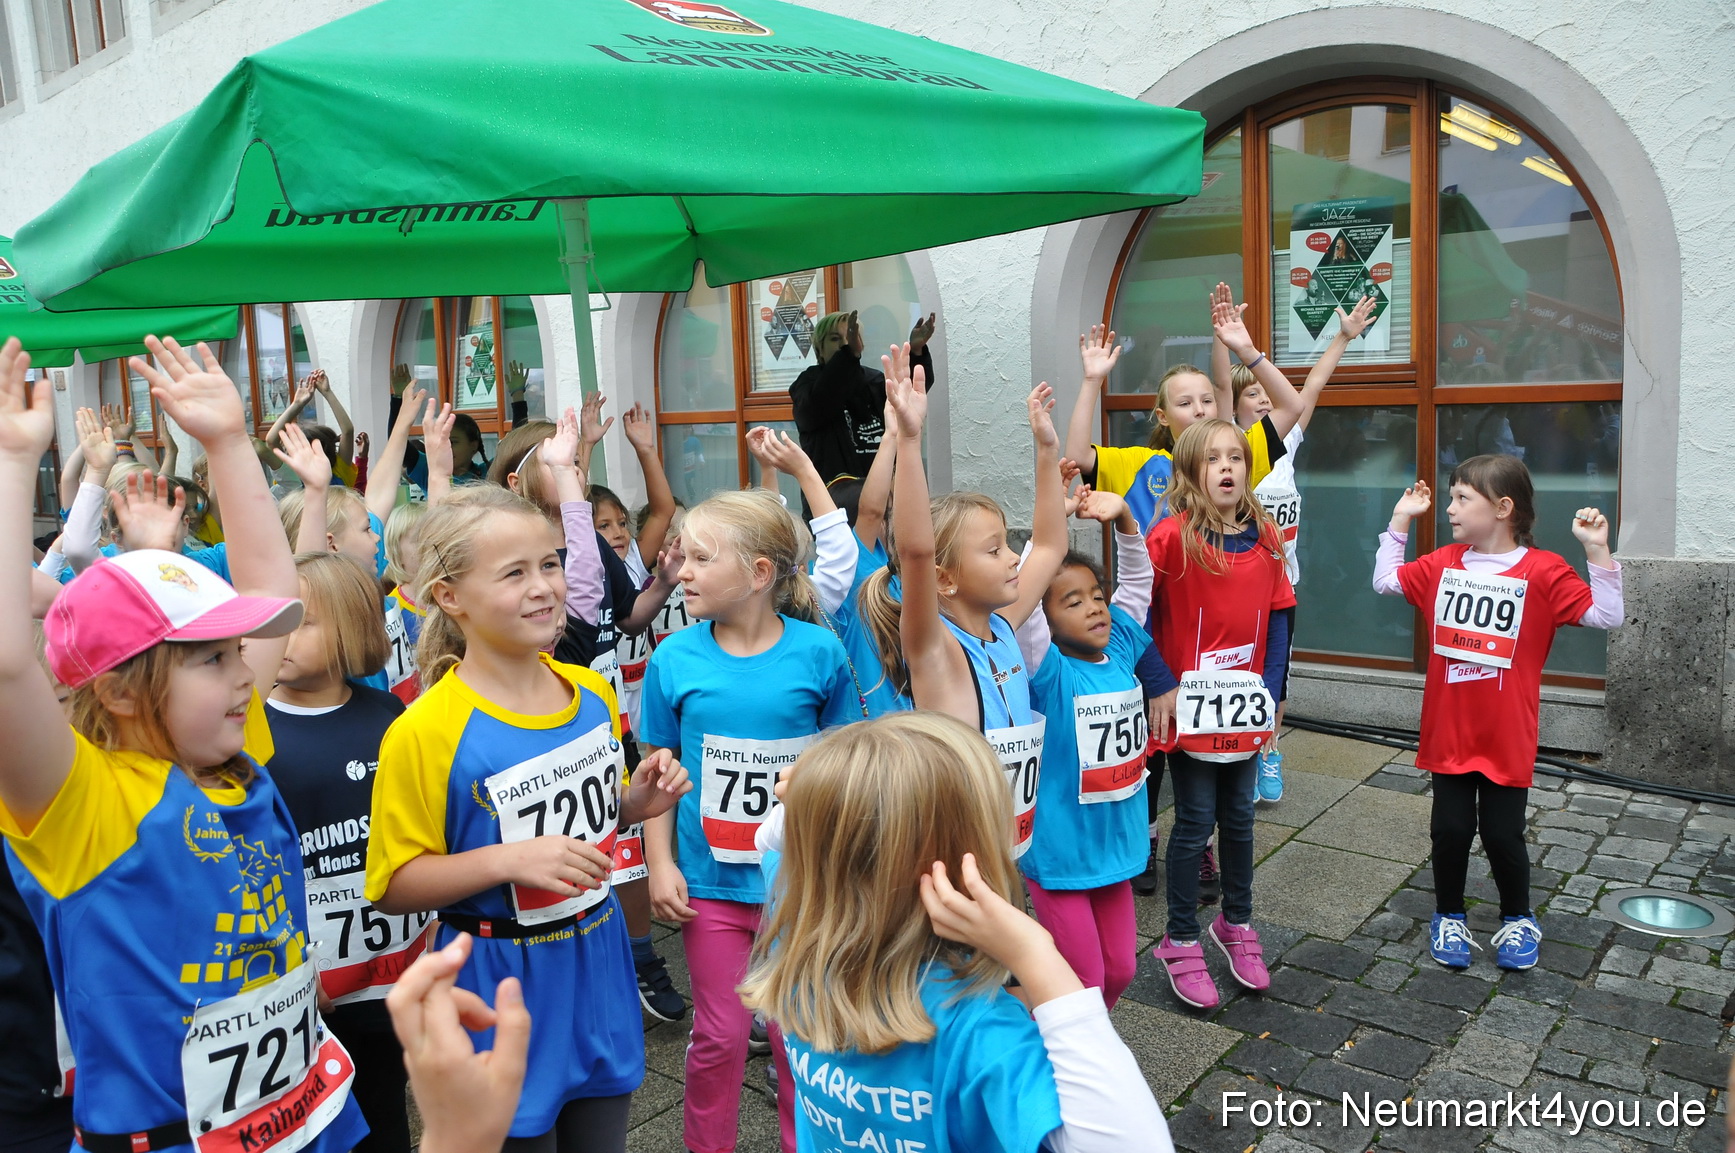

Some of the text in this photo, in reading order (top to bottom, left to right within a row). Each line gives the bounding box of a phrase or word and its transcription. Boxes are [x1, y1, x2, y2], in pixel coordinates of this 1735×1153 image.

[621, 33, 899, 66] Neumarkter
[587, 44, 992, 91] Lammsbräu
[1322, 206, 1355, 221] JAZZ
[1465, 580, 1511, 595] Neumarkt
[1443, 591, 1516, 632] 7009
[1452, 633, 1481, 650] Anna
[1215, 652, 1240, 665] DEHN
[1458, 665, 1483, 677] DEHN
[1180, 680, 1257, 690] PARTL Neumarkt
[1077, 705, 1118, 718] PARTL
[1186, 693, 1267, 729] 7123
[1213, 737, 1239, 750] Lisa
[705, 747, 749, 763] PARTL
[497, 745, 608, 805] PARTL Neumarkt
[518, 764, 618, 842] 7203
[205, 812, 221, 824] 15
[195, 826, 229, 840] Jahre
[298, 815, 371, 857] RUNDS
[318, 852, 361, 874] Haus
[309, 887, 361, 906] PARTL
[186, 1012, 259, 1046] PARTL
[208, 992, 318, 1115] 721
